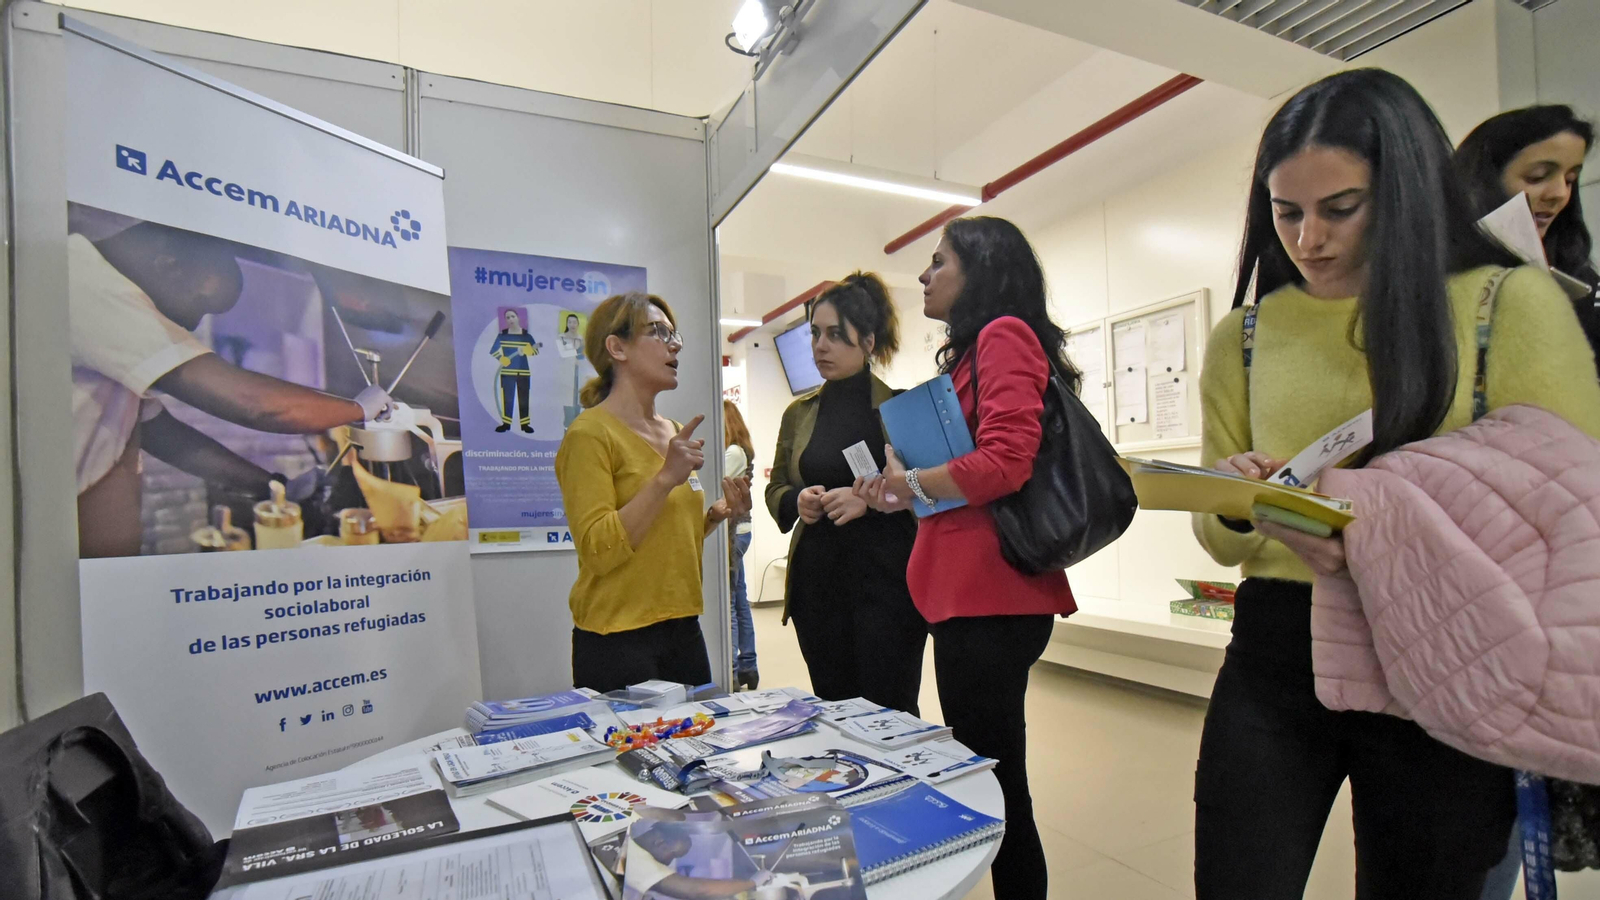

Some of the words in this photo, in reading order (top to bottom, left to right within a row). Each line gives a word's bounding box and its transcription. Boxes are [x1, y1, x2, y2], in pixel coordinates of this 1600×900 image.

[156, 159, 280, 213] Accem
[285, 200, 398, 248] ARIADNA
[474, 266, 608, 294] #mujeresin
[465, 449, 529, 458] discriminación,
[531, 450, 543, 458] sin
[170, 579, 289, 604] Trabajando
[293, 577, 323, 596] por
[327, 576, 342, 590] la
[345, 569, 431, 588] integración
[264, 595, 370, 619] sociolaboral
[188, 639, 216, 655] de
[222, 634, 251, 651] las
[256, 622, 341, 649] personas
[344, 611, 426, 633] refugiadas
[254, 668, 388, 704] www.accem.es
[265, 761, 289, 772] Agencia
[297, 751, 327, 763] Colocación
[742, 805, 774, 816] Accem
[774, 800, 812, 810] ARIADNA
[427, 821, 444, 831] LA
[363, 826, 424, 848] SOLEDAD
[755, 832, 790, 844] Accem
[791, 824, 833, 838] ARIADNA
[319, 846, 337, 855] LA
[341, 841, 359, 851] DE
[793, 839, 824, 849] Trabajando
[793, 844, 824, 853] integración
[243, 849, 285, 860] Accem
[282, 850, 315, 862] SRA.
[786, 849, 812, 859] personas
[812, 845, 841, 857] refugiadas
[242, 859, 277, 871] VILA
